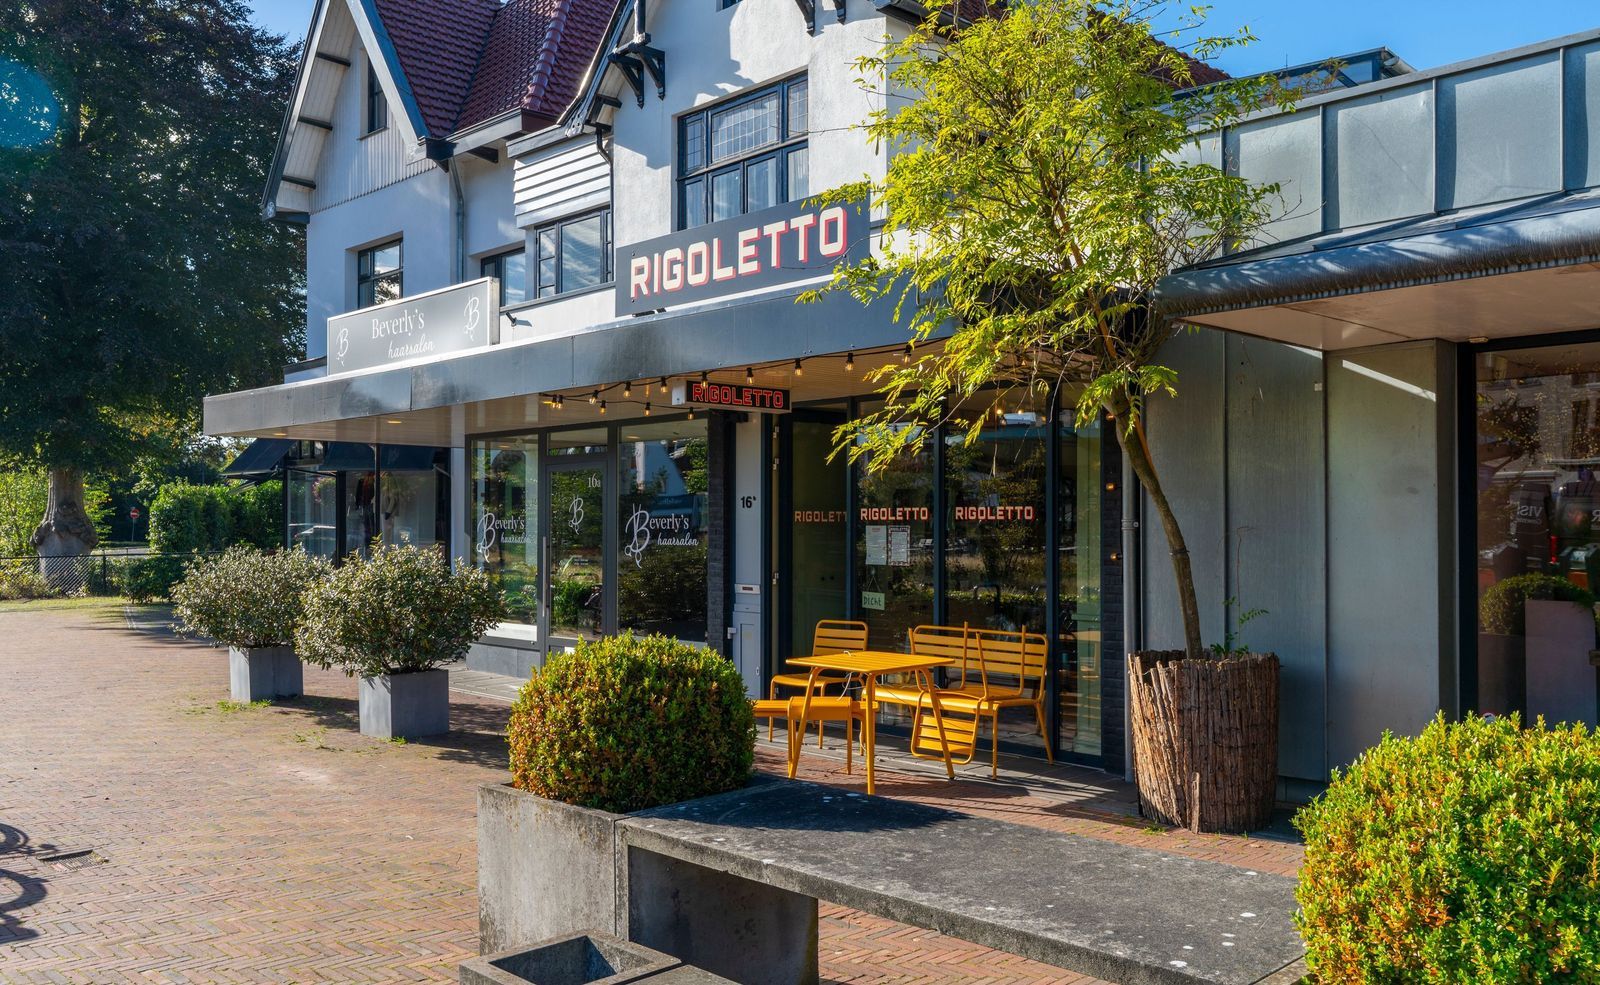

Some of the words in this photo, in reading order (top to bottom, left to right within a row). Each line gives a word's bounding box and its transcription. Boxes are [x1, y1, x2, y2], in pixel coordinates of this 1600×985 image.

[630, 206, 848, 298] RIGOLETTO
[371, 308, 425, 339] Beverly's
[387, 335, 436, 359] haarsalon
[692, 383, 784, 409] RIGOLETTO
[794, 511, 848, 522] RIGOLETT
[860, 507, 929, 521] RIGOLETTO
[954, 506, 1034, 521] RIGOLETTO
[476, 511, 525, 552] Beverly's
[625, 510, 690, 554] Beverly's
[657, 532, 699, 546] haarsalon
